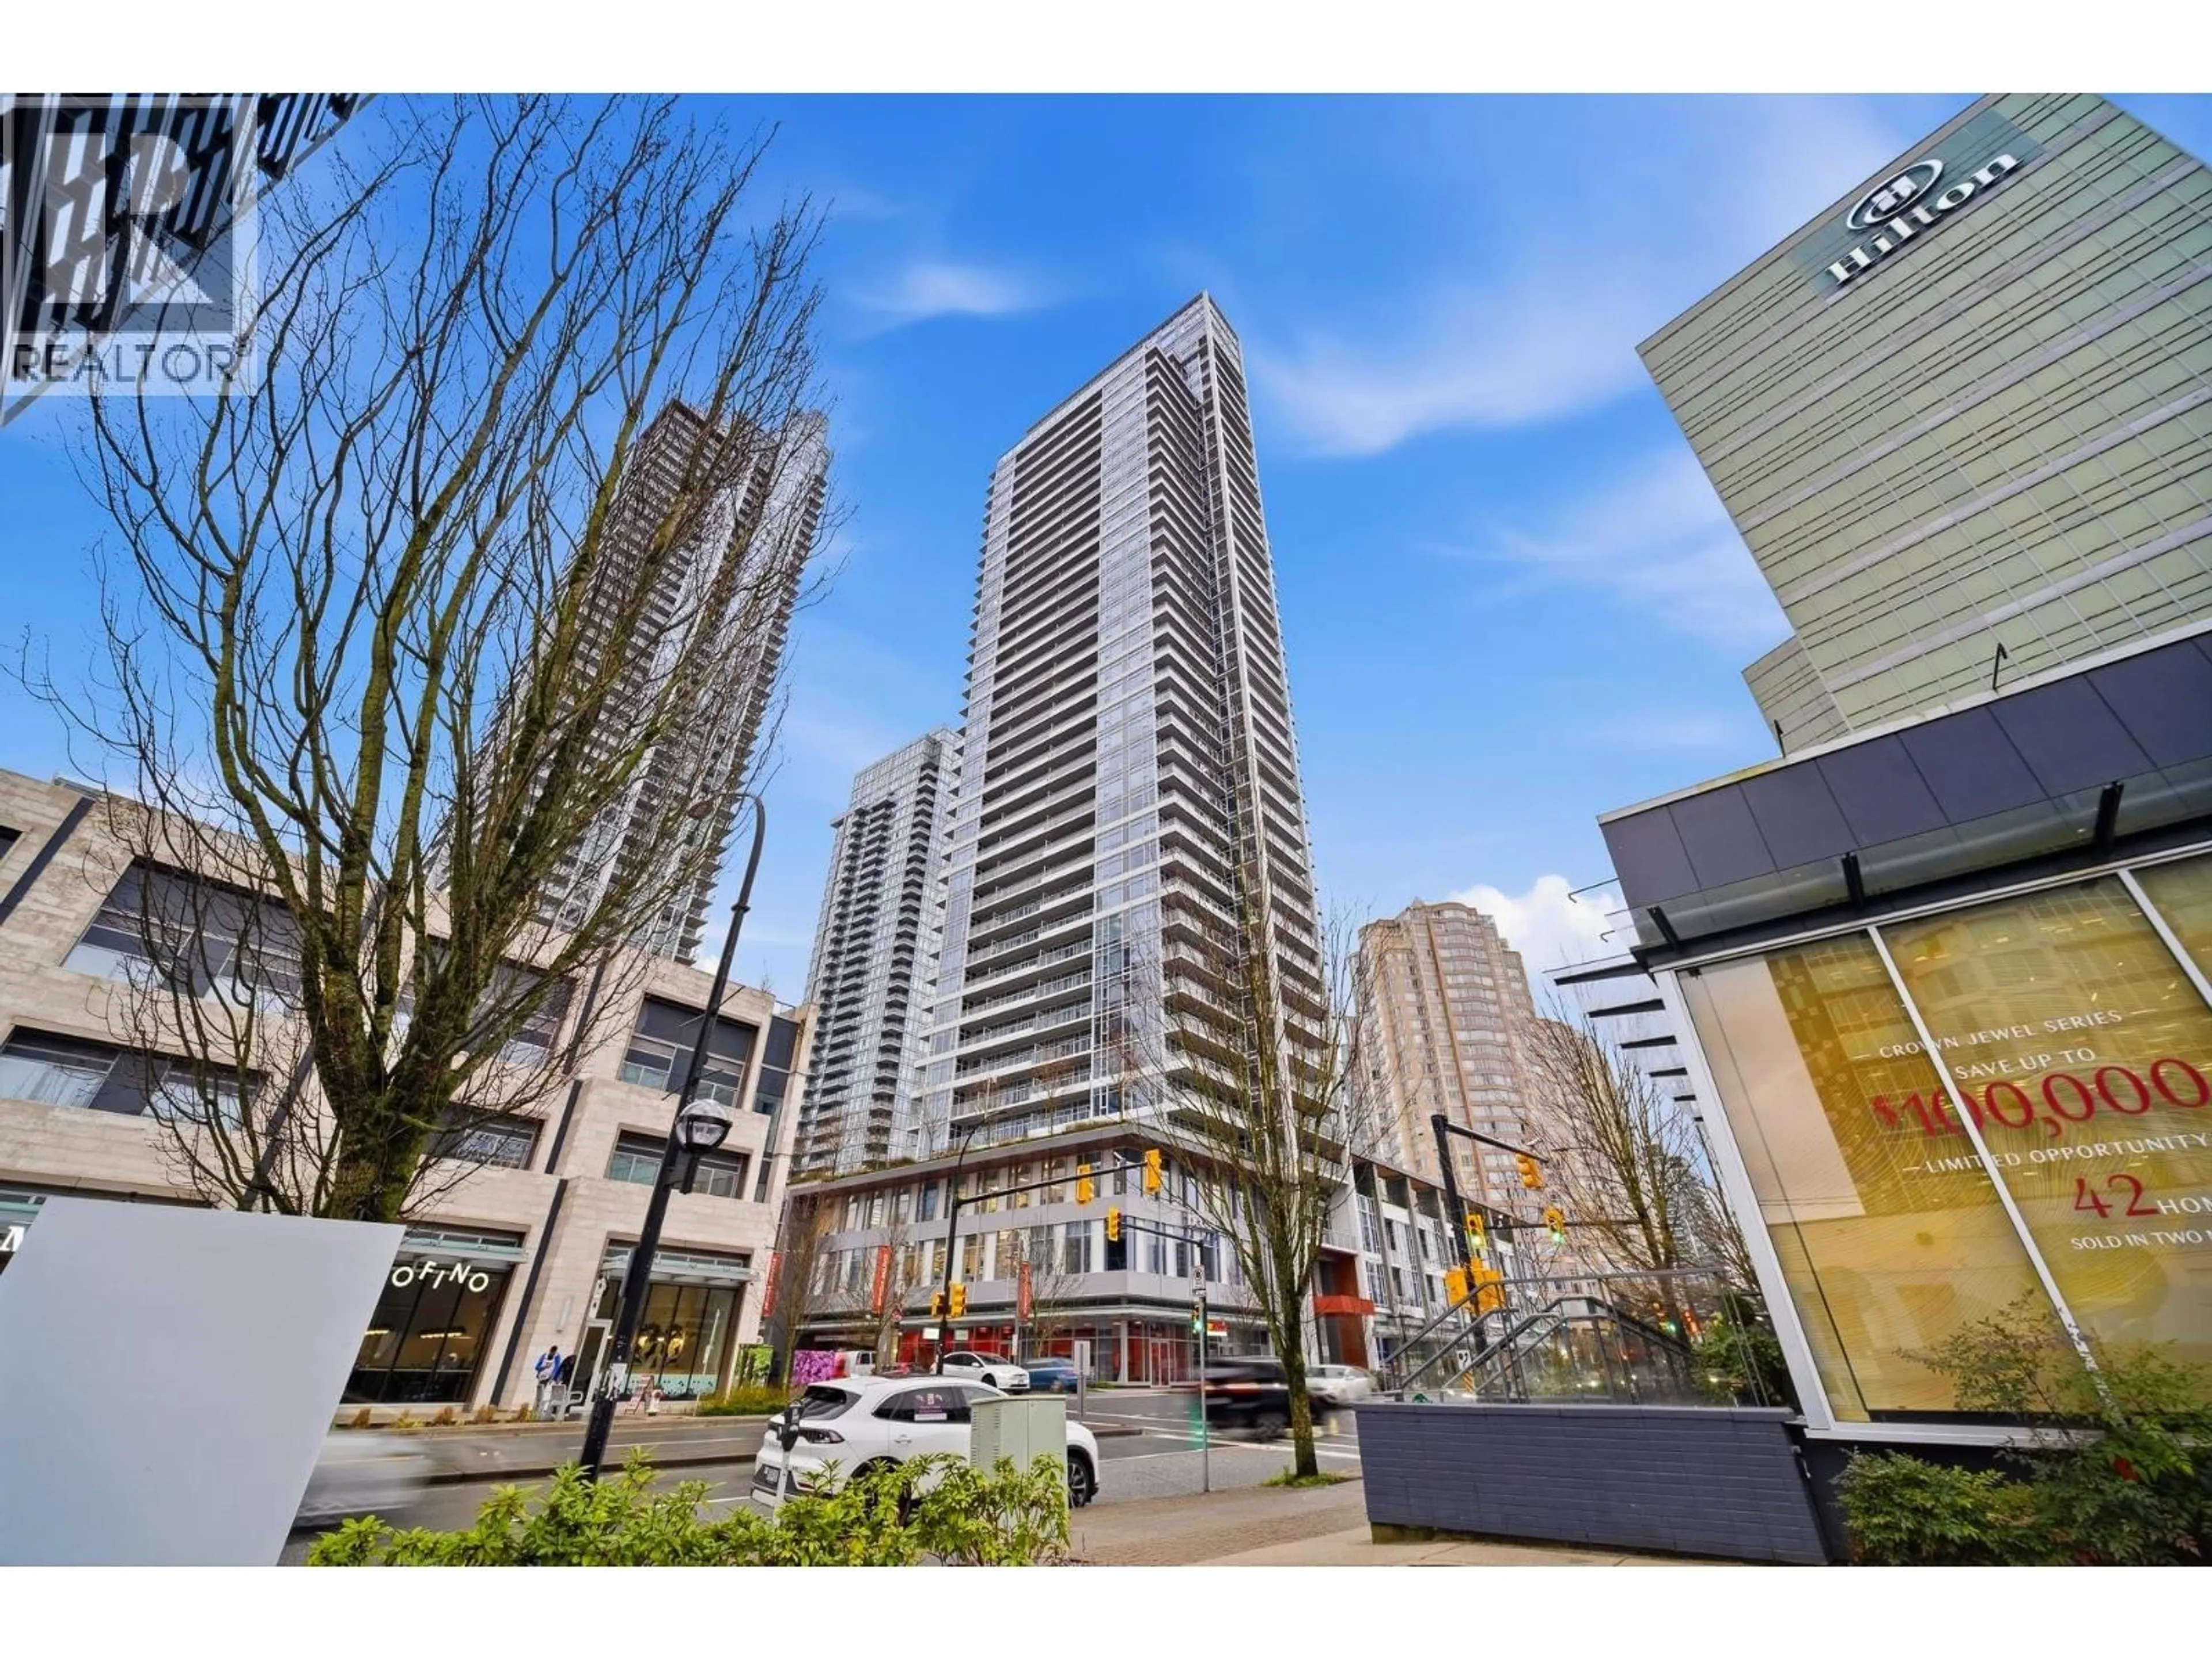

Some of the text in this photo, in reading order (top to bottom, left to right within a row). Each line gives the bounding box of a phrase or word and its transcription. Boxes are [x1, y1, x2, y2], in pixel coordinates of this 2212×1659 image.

[1825, 154, 2021, 286] Hilton
[1880, 1010, 2123, 1058] CROWN JEWEL SERIES
[1955, 1047, 2096, 1079] SAVE UP TO
[1872, 1058, 2210, 1138] $100,000
[1926, 1132, 2209, 1173] LIMITED OPPORTUNITY
[2075, 1174, 2160, 1218] 42
[2071, 1236, 2122, 1249] SOLD
[2125, 1234, 2149, 1247] IN
[2150, 1230, 2203, 1244] TWO
[391, 1260, 489, 1293] OFINO
